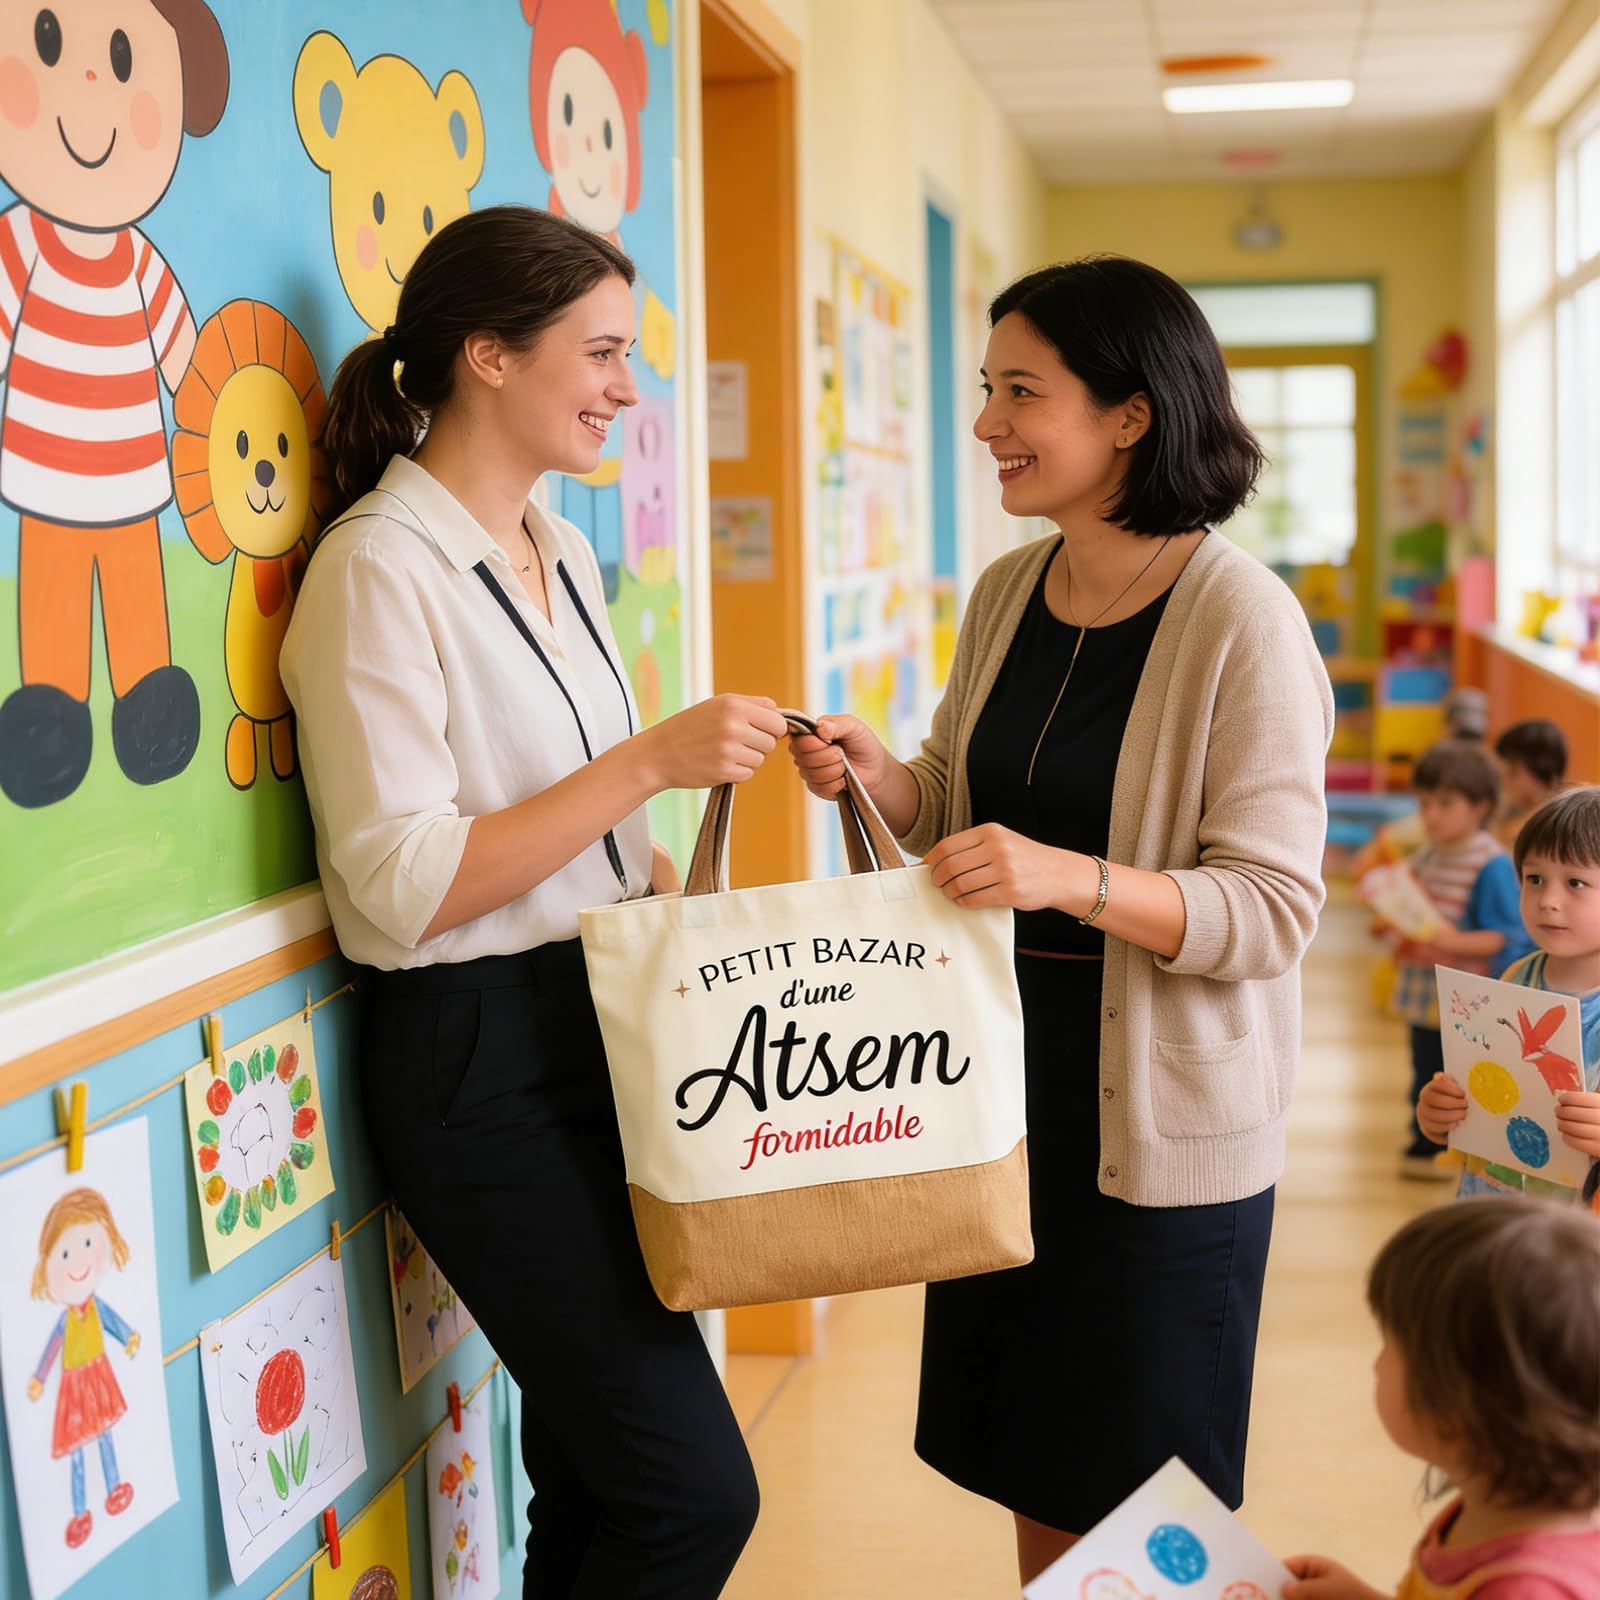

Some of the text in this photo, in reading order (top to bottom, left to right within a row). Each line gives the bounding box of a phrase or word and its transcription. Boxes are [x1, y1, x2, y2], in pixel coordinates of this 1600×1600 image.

[698, 937, 926, 992] PETIT BAZAR
[779, 978, 856, 1009] d'une
[674, 1004, 971, 1132] Atsem
[739, 1104, 924, 1171] formidable
